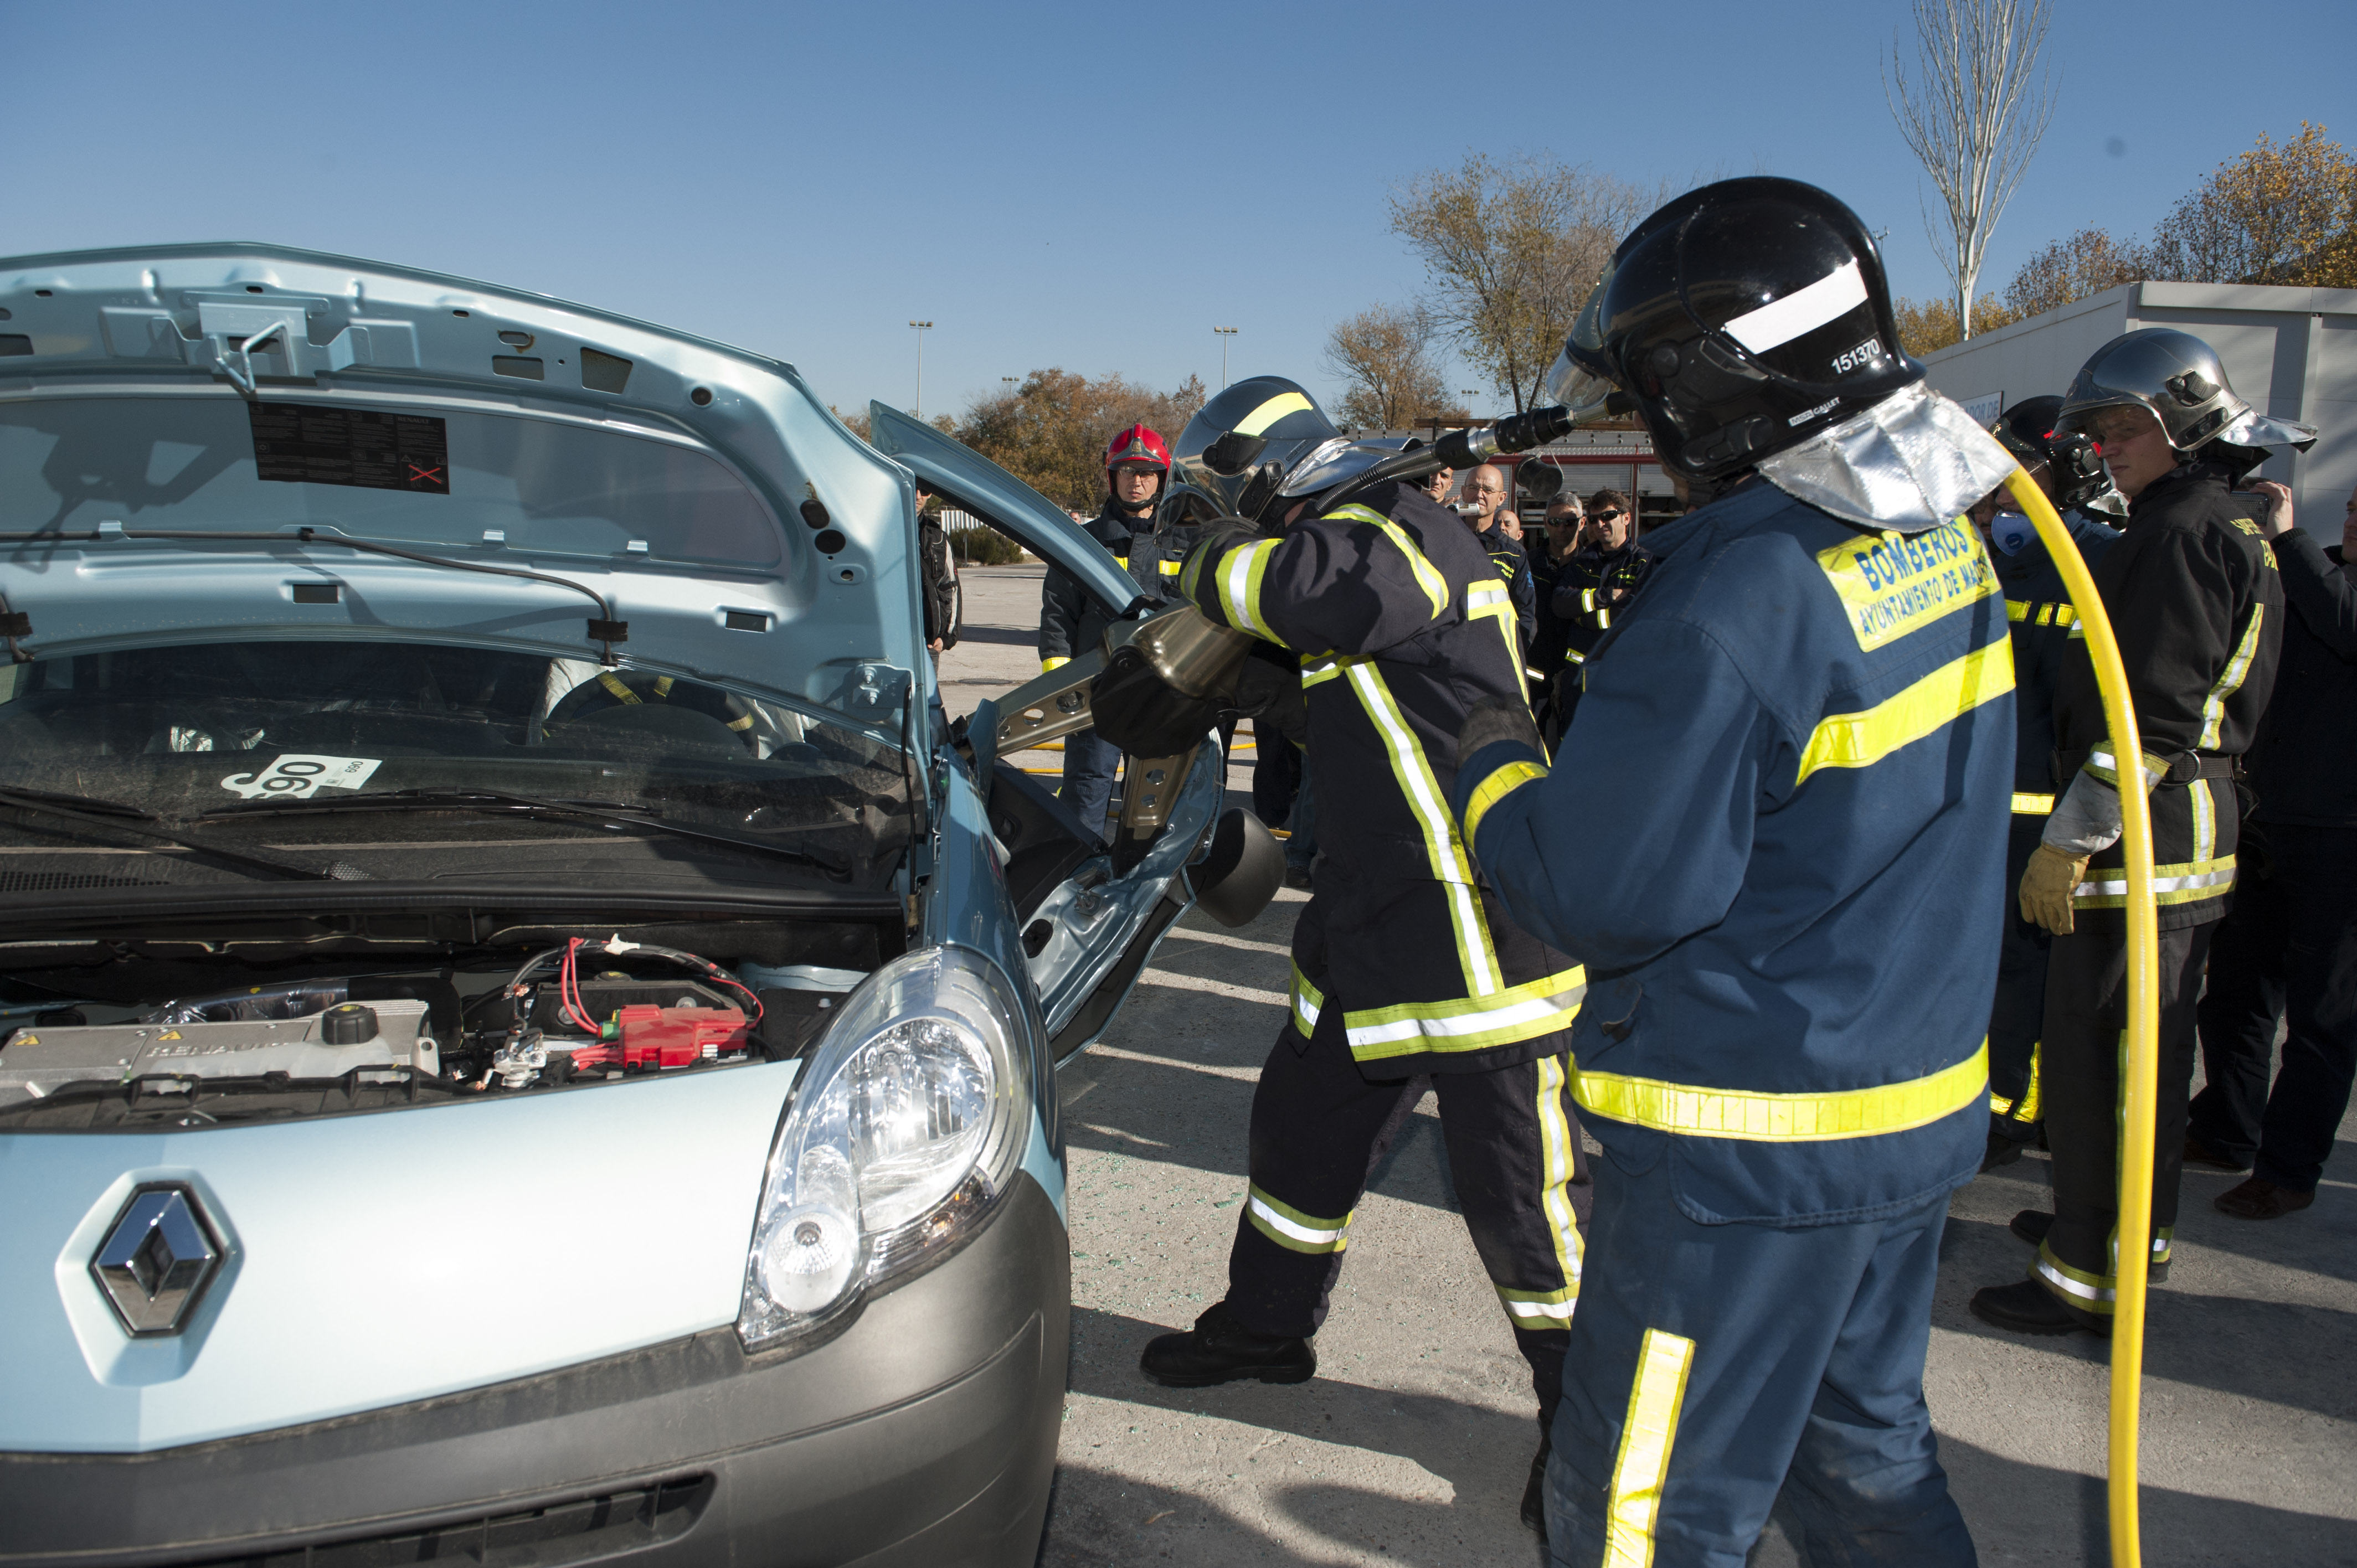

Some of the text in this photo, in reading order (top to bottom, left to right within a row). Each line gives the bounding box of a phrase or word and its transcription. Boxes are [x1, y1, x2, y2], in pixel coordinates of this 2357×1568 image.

[1831, 339, 1880, 374] 151370
[1813, 396, 1840, 415] GALLET
[1964, 400, 1999, 420] DOR DE
[1854, 520, 1969, 592] BOMBEROS
[1859, 576, 1942, 637] AYUNTAMIENTO
[1942, 569, 1961, 598] DE
[344, 761, 364, 773] 690
